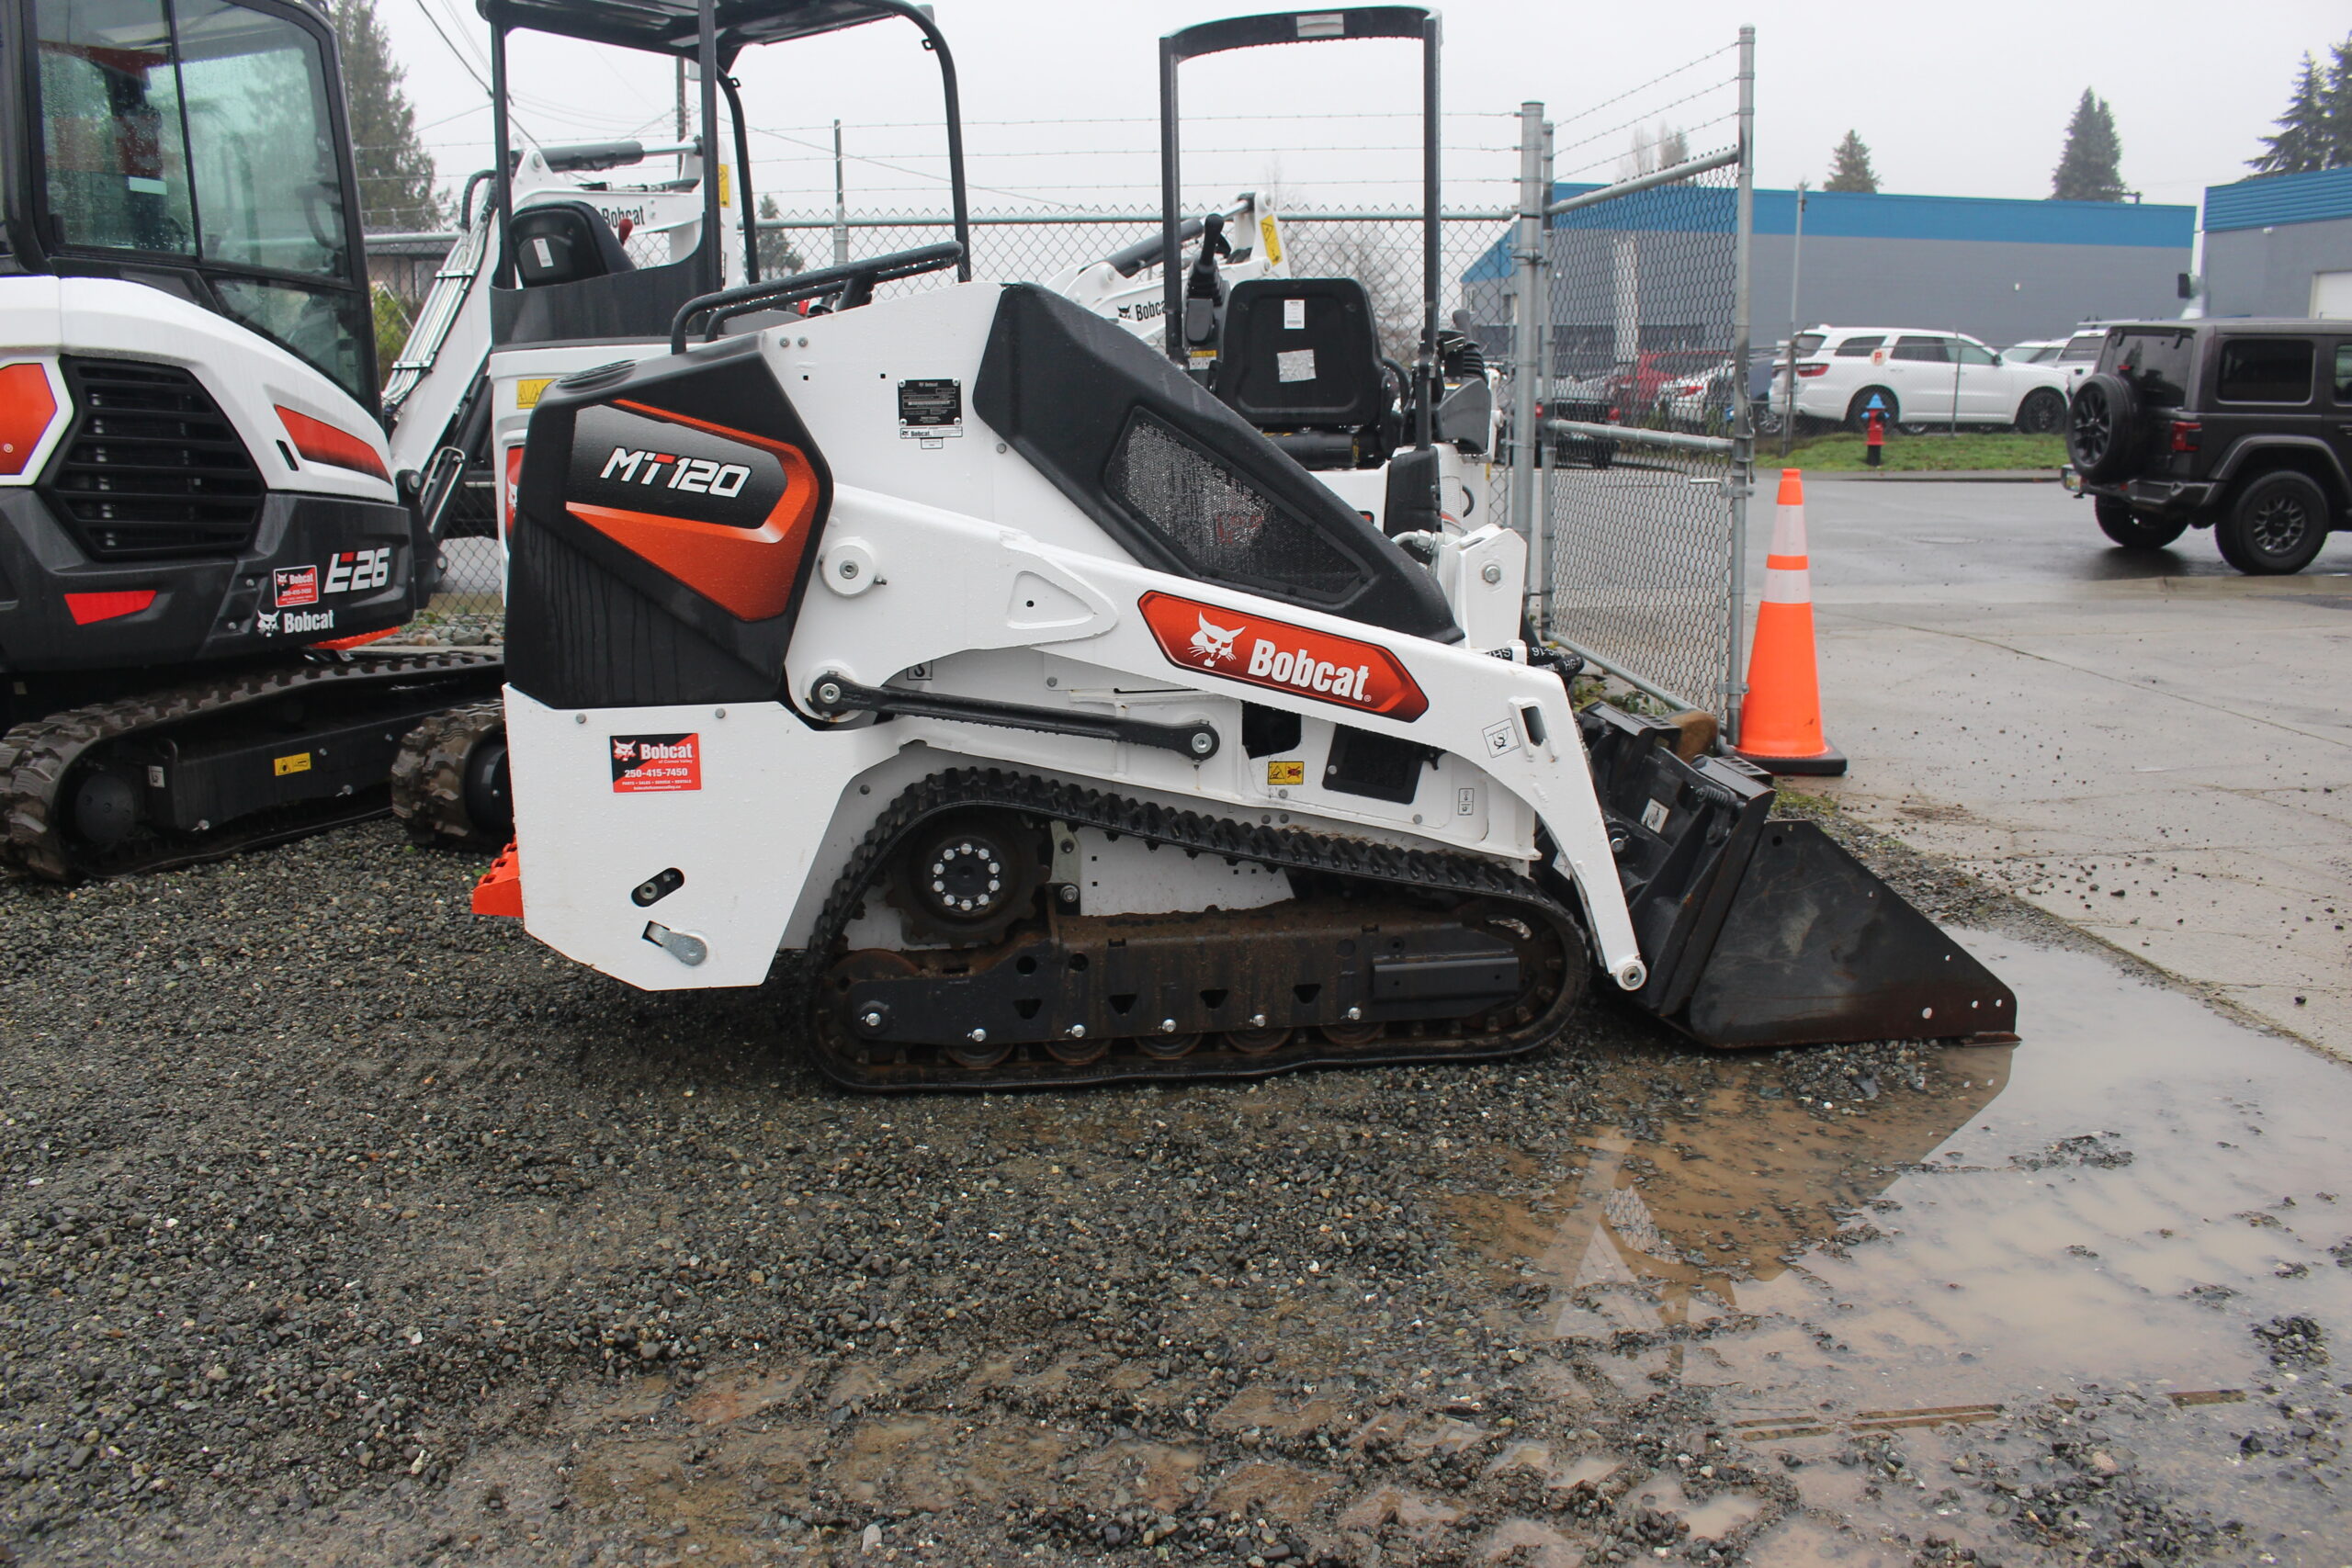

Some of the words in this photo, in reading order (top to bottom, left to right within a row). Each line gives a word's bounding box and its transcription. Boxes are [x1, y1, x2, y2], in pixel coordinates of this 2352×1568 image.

[1136, 301, 1166, 321] Bobca
[599, 446, 752, 499] MT120
[289, 573, 313, 584] Bobcat
[323, 547, 390, 594] E26
[284, 609, 334, 634] Bobcat
[640, 742, 694, 761] Bobcat
[624, 767, 688, 778] 250-415-7450
